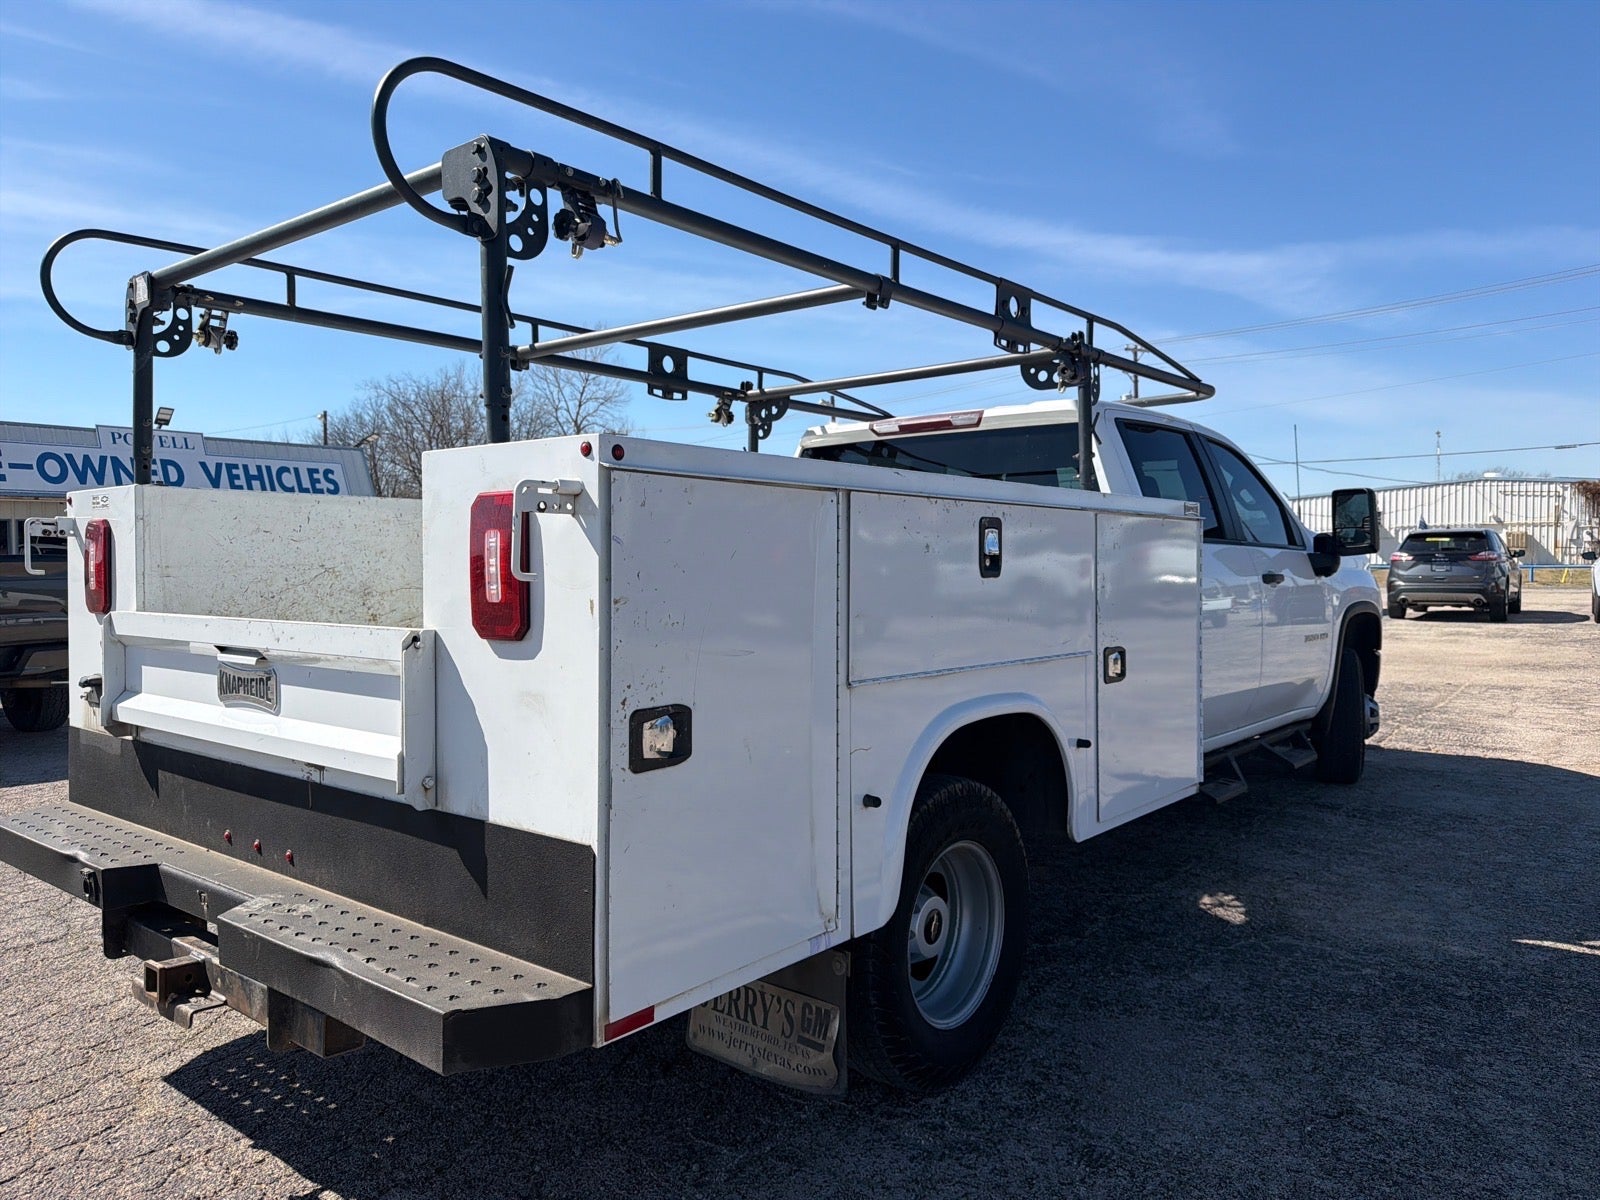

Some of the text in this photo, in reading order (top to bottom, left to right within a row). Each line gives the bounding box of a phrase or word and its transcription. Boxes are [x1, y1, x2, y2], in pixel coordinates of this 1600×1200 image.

[110, 431, 196, 450] POELL
[198, 461, 340, 495] VEHICLES
[219, 669, 272, 703] KNAPHEIDE
[700, 985, 832, 1041] ERRY'S GM
[698, 1023, 828, 1077] www.jerrystexas.com
[782, 1040, 811, 1060] TEXAS
